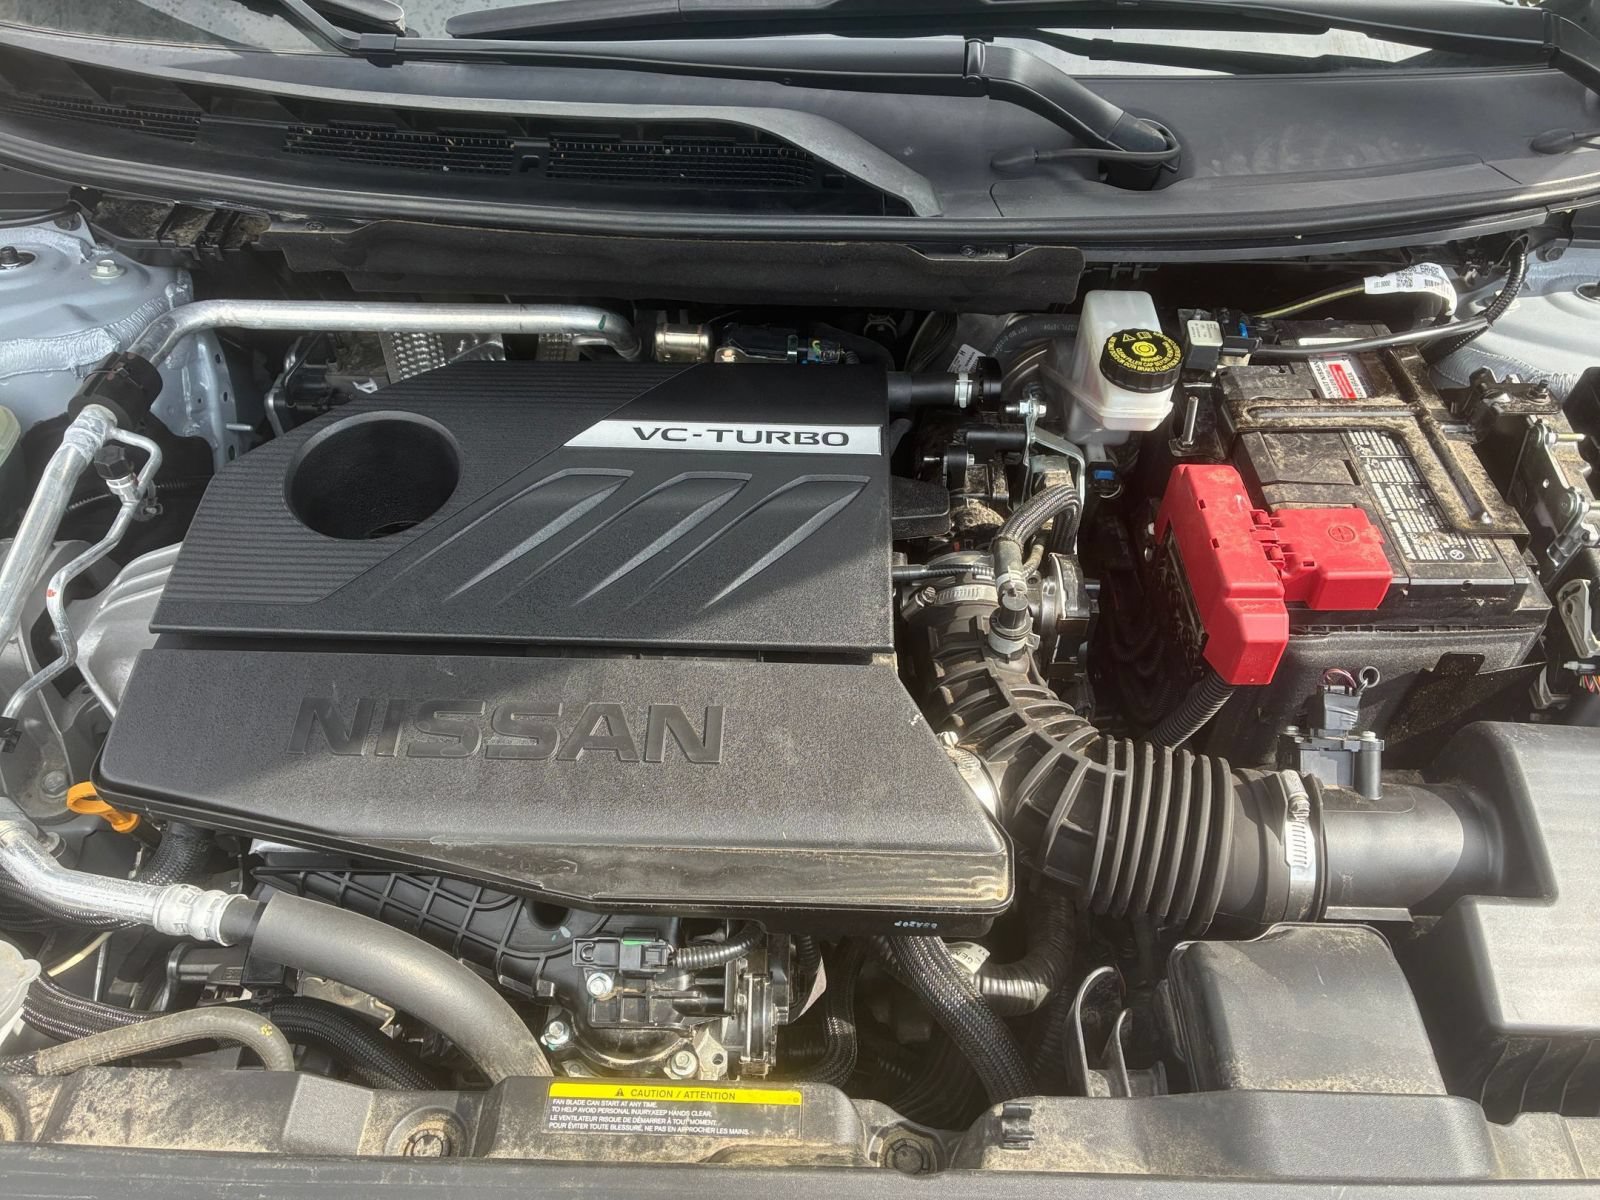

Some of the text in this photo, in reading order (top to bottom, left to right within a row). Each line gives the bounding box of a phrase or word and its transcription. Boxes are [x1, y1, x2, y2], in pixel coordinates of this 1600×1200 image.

[632, 426, 850, 446] VC-TURBO
[287, 695, 726, 764] NISSAN
[630, 1089, 675, 1098] CAUTION
[684, 1090, 735, 1100] ATTENTION
